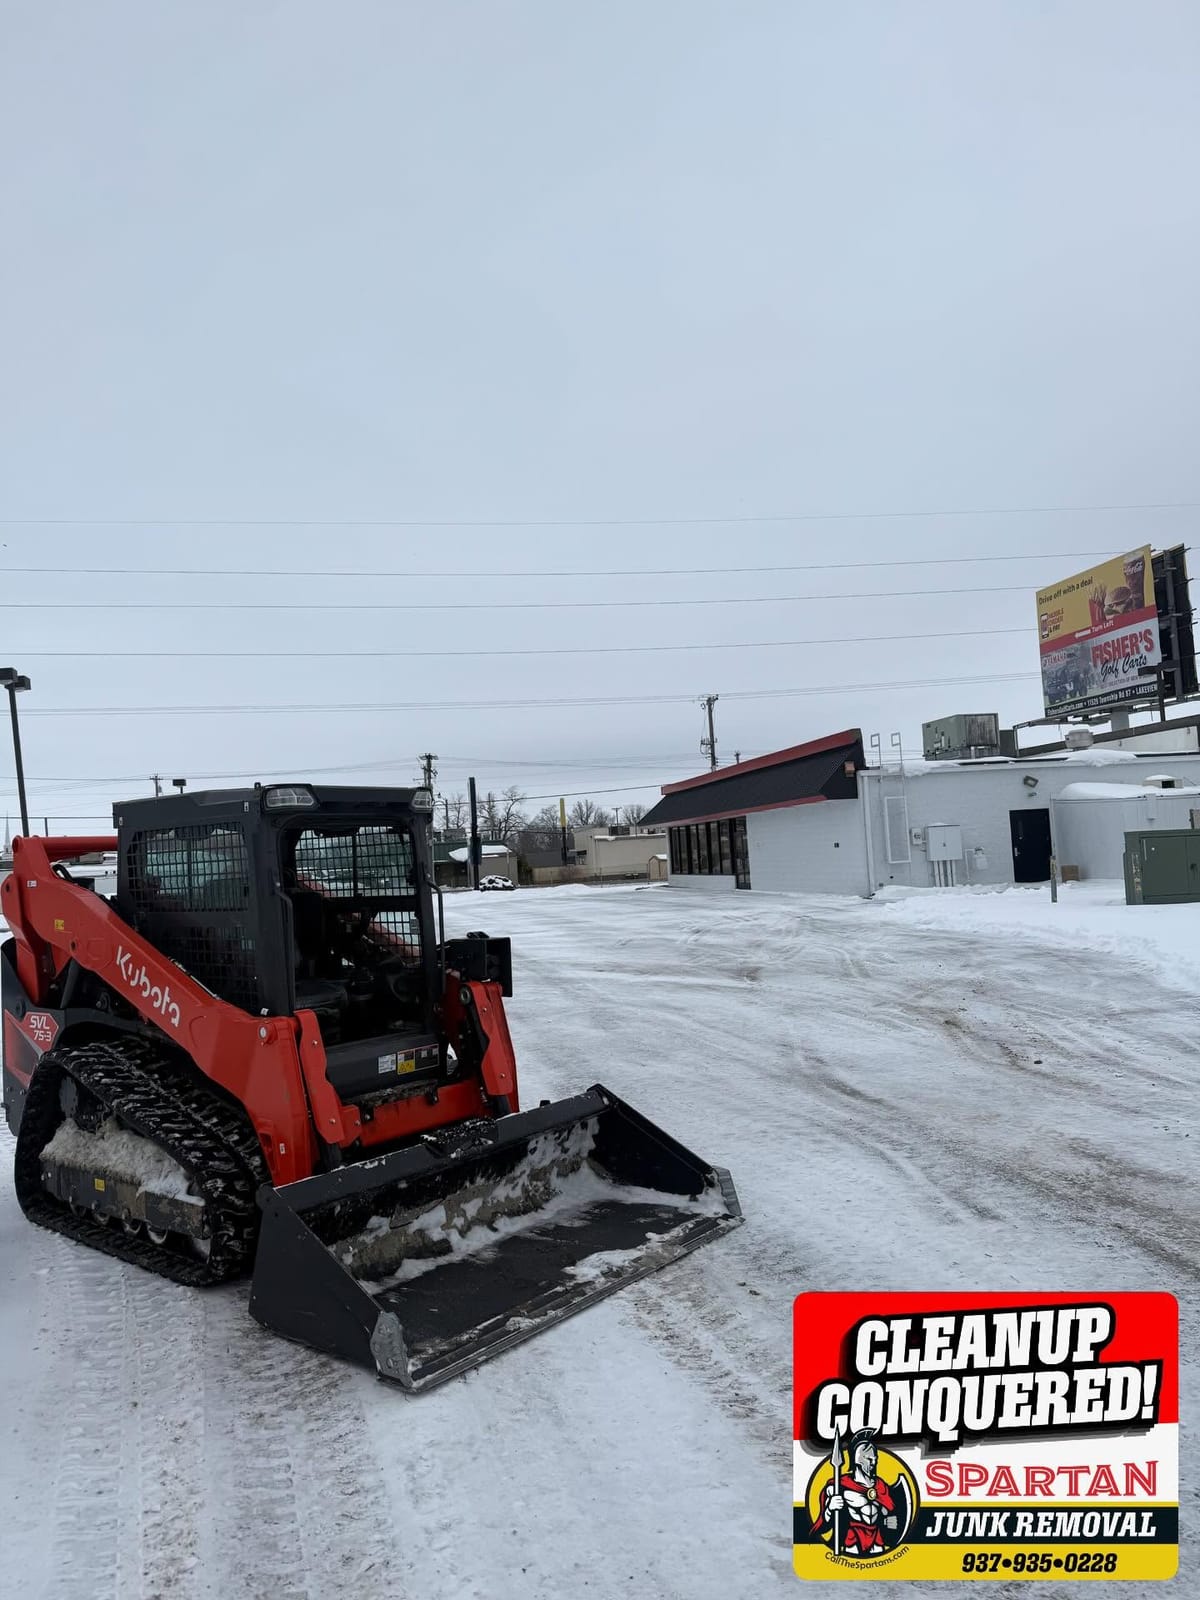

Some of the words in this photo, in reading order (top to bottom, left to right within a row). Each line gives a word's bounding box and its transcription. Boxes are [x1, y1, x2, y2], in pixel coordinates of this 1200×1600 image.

[1039, 594, 1053, 605] Drive
[1053, 588, 1062, 599] off
[1062, 584, 1076, 596] with
[1080, 576, 1093, 587] deal
[1092, 624, 1103, 632] Turn
[1103, 619, 1114, 629] Left
[1091, 628, 1155, 667] FISHER'S
[1101, 658, 1119, 682] Golf
[1122, 653, 1147, 674] Carts
[116, 945, 181, 1028] Kubota
[29, 1015, 50, 1030] SVL
[33, 1030, 52, 1041] 75-3
